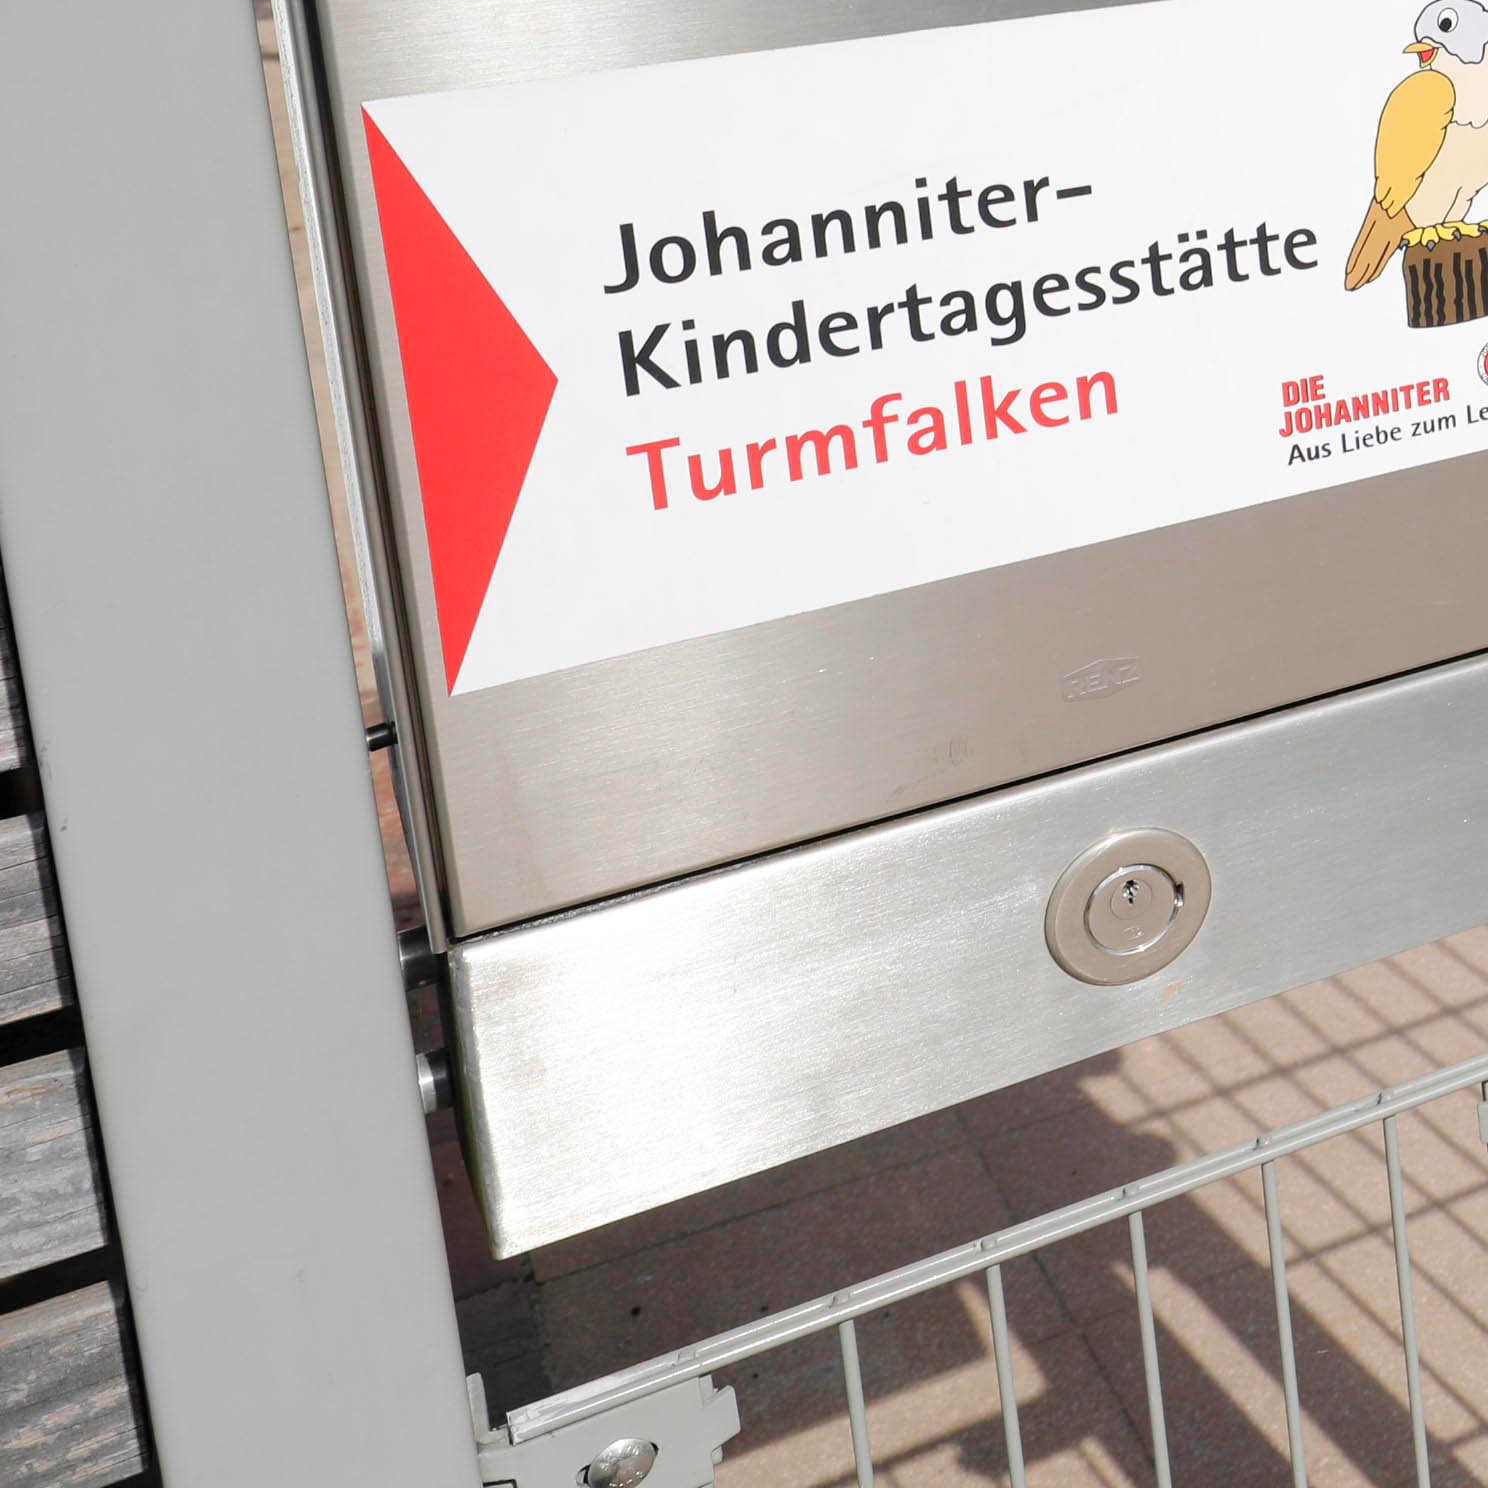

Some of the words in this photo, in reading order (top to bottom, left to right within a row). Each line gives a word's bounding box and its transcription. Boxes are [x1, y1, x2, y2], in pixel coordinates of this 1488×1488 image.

[603, 176, 1092, 294] Johanniter-
[618, 223, 1318, 398] Kindertagesstätte
[1279, 377, 1451, 438] JOHANNITER
[1281, 374, 1326, 408] DIE
[626, 371, 1118, 510] Turmfalken
[1287, 443, 1333, 466] Aus
[1341, 425, 1402, 454] Liebe
[1411, 414, 1457, 438] zum
